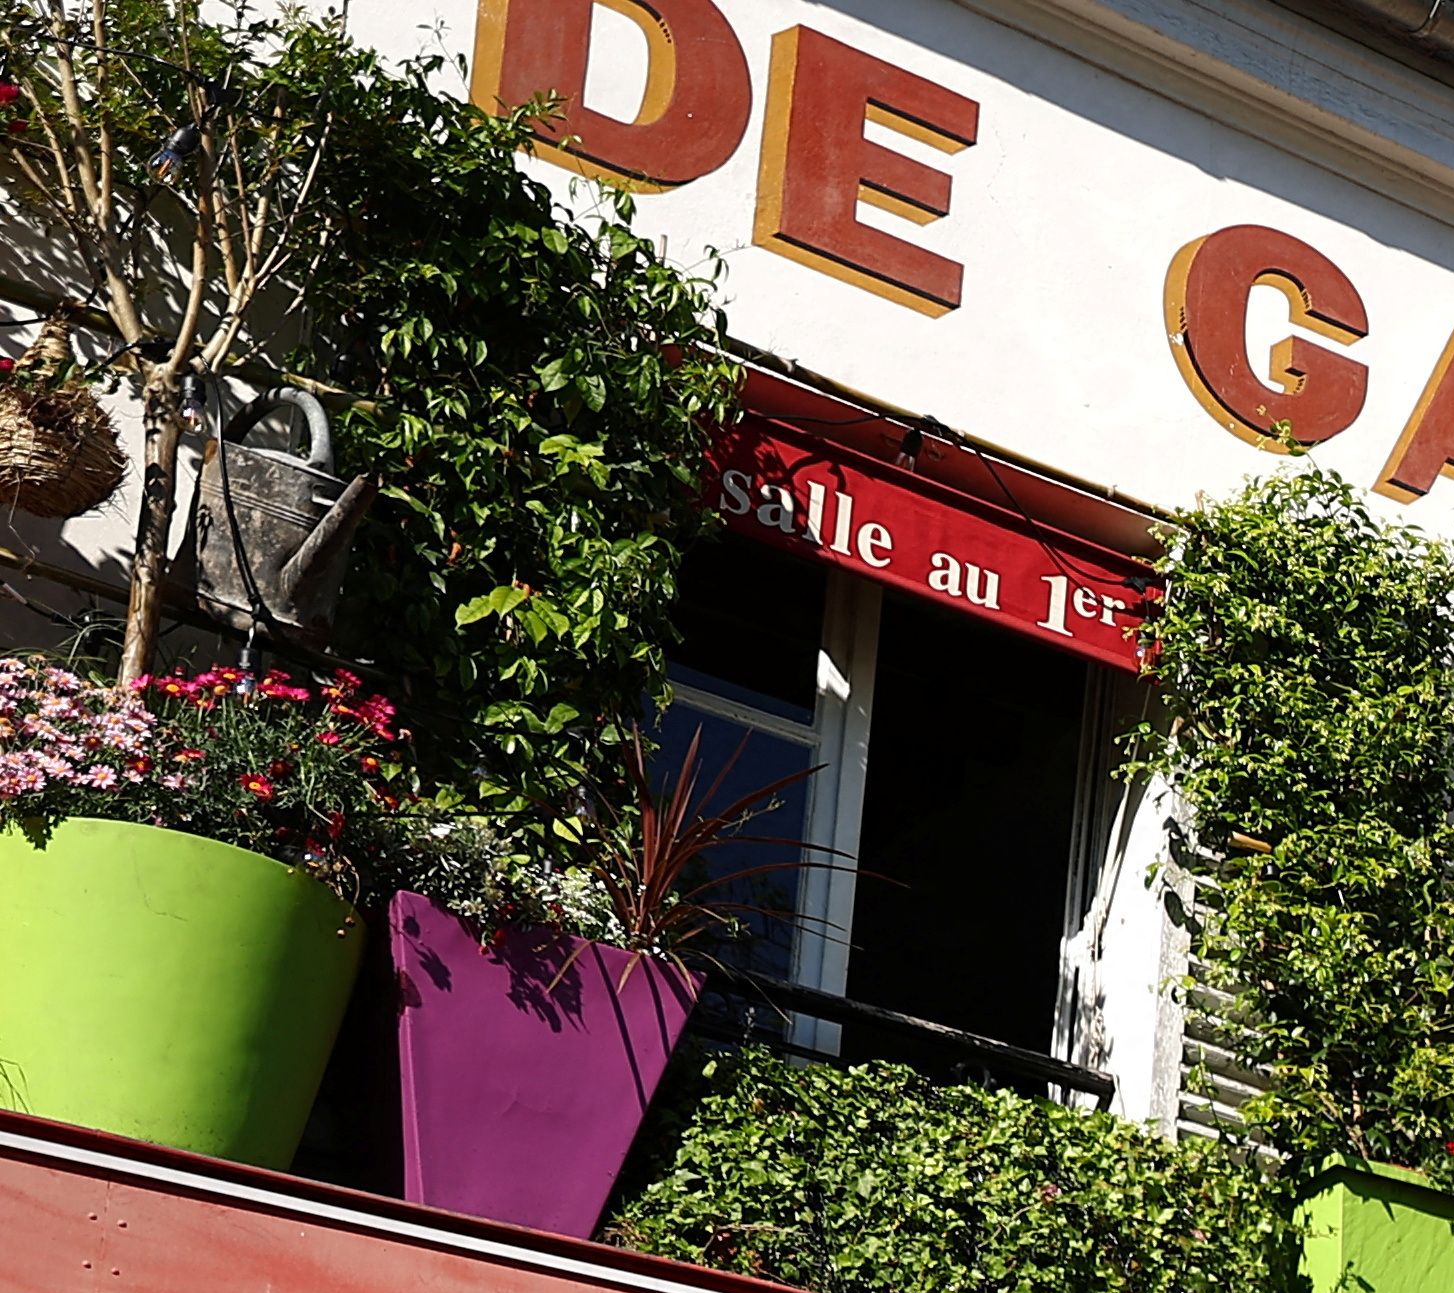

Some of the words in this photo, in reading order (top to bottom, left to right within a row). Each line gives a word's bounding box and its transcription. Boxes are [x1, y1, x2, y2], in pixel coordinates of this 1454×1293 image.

[469, 0, 979, 319] DE
[719, 466, 894, 569] salle
[927, 550, 1002, 611] au
[1035, 573, 1127, 638] 1er
